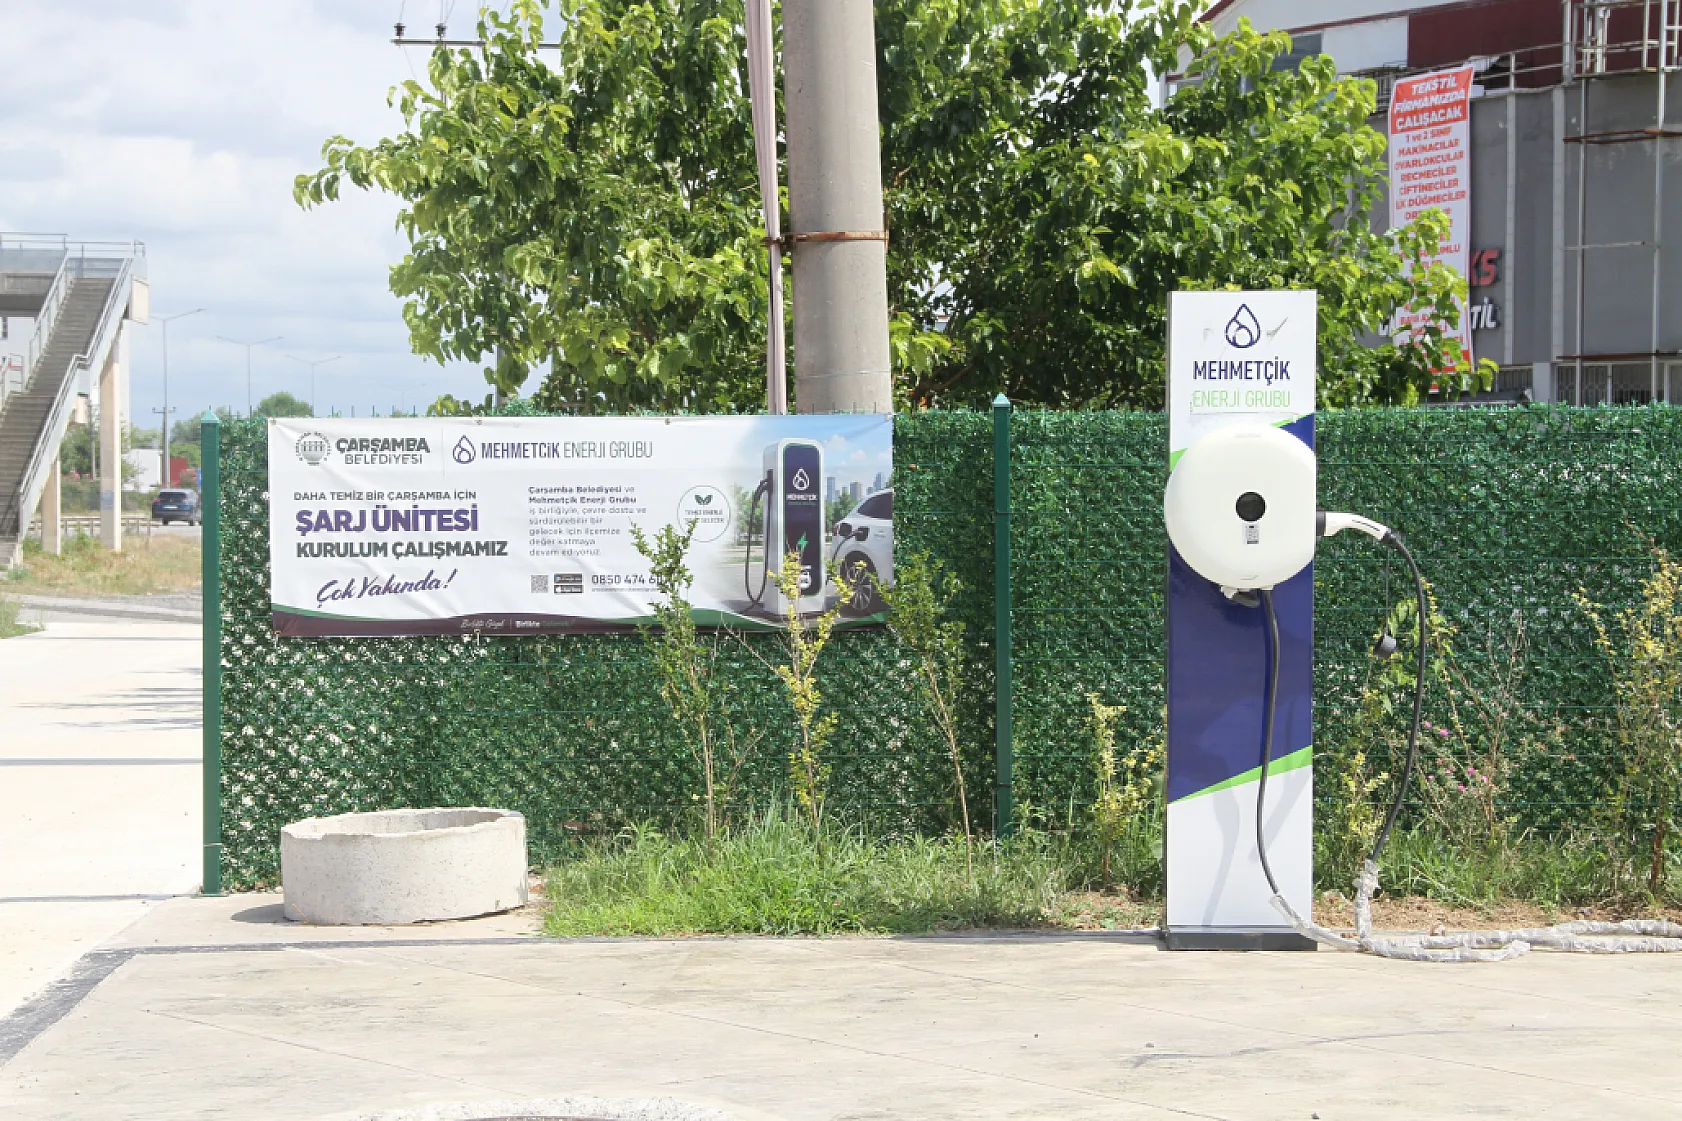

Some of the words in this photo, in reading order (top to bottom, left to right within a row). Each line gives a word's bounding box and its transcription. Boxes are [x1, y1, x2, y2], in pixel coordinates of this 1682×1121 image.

[1411, 74, 1458, 95] TEKSTİL
[1396, 105, 1463, 132] ÇALIŞACAK
[1192, 356, 1291, 386] MEHMETÇİK
[1245, 390, 1291, 408] GRUBU
[336, 437, 431, 454] ÇARŞAMBA
[609, 440, 653, 459] GRUBU
[293, 491, 327, 501] DAHA
[330, 490, 364, 501] TEMİZ
[365, 490, 385, 501] BİR
[387, 491, 452, 502] ÇARŞAMBA
[454, 488, 477, 502] İÇİN
[295, 509, 367, 537] ŞARJ
[372, 503, 478, 532] ÜNİTESİ
[296, 542, 388, 558] KURULUM
[392, 541, 509, 560] ÇALIŞMAMIZ
[591, 574, 622, 585] 0850
[624, 574, 645, 585] 474
